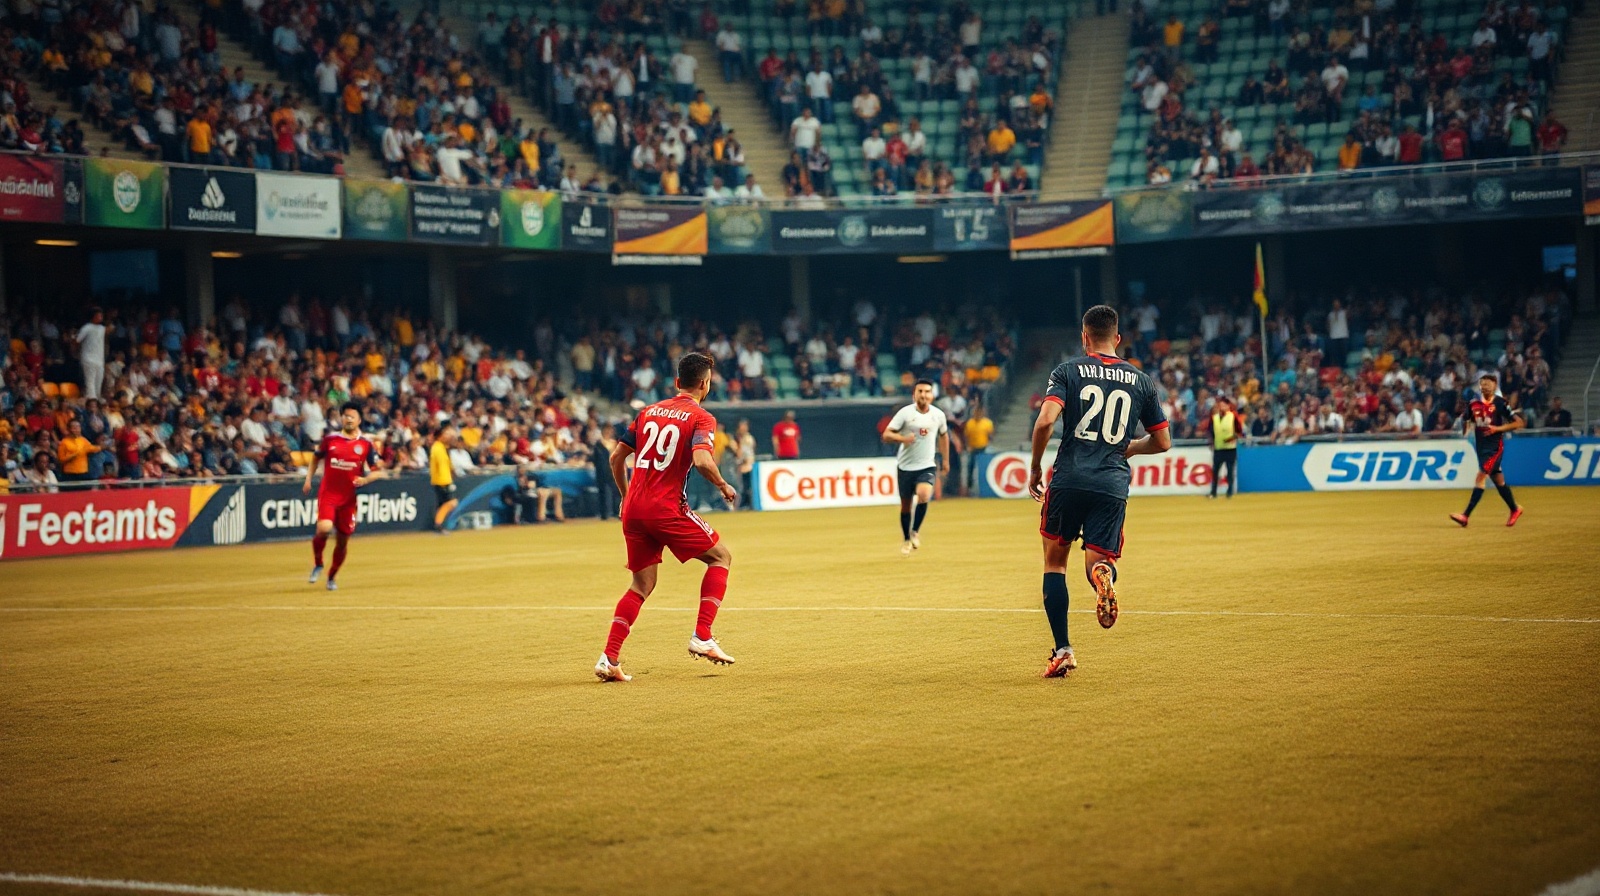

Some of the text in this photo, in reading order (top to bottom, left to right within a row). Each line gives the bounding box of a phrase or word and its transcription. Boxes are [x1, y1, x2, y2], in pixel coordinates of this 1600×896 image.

[1074, 384, 1132, 445] 20
[636, 421, 680, 471] 29
[767, 466, 894, 502] Centrio
[17, 500, 177, 547] Fectamts
